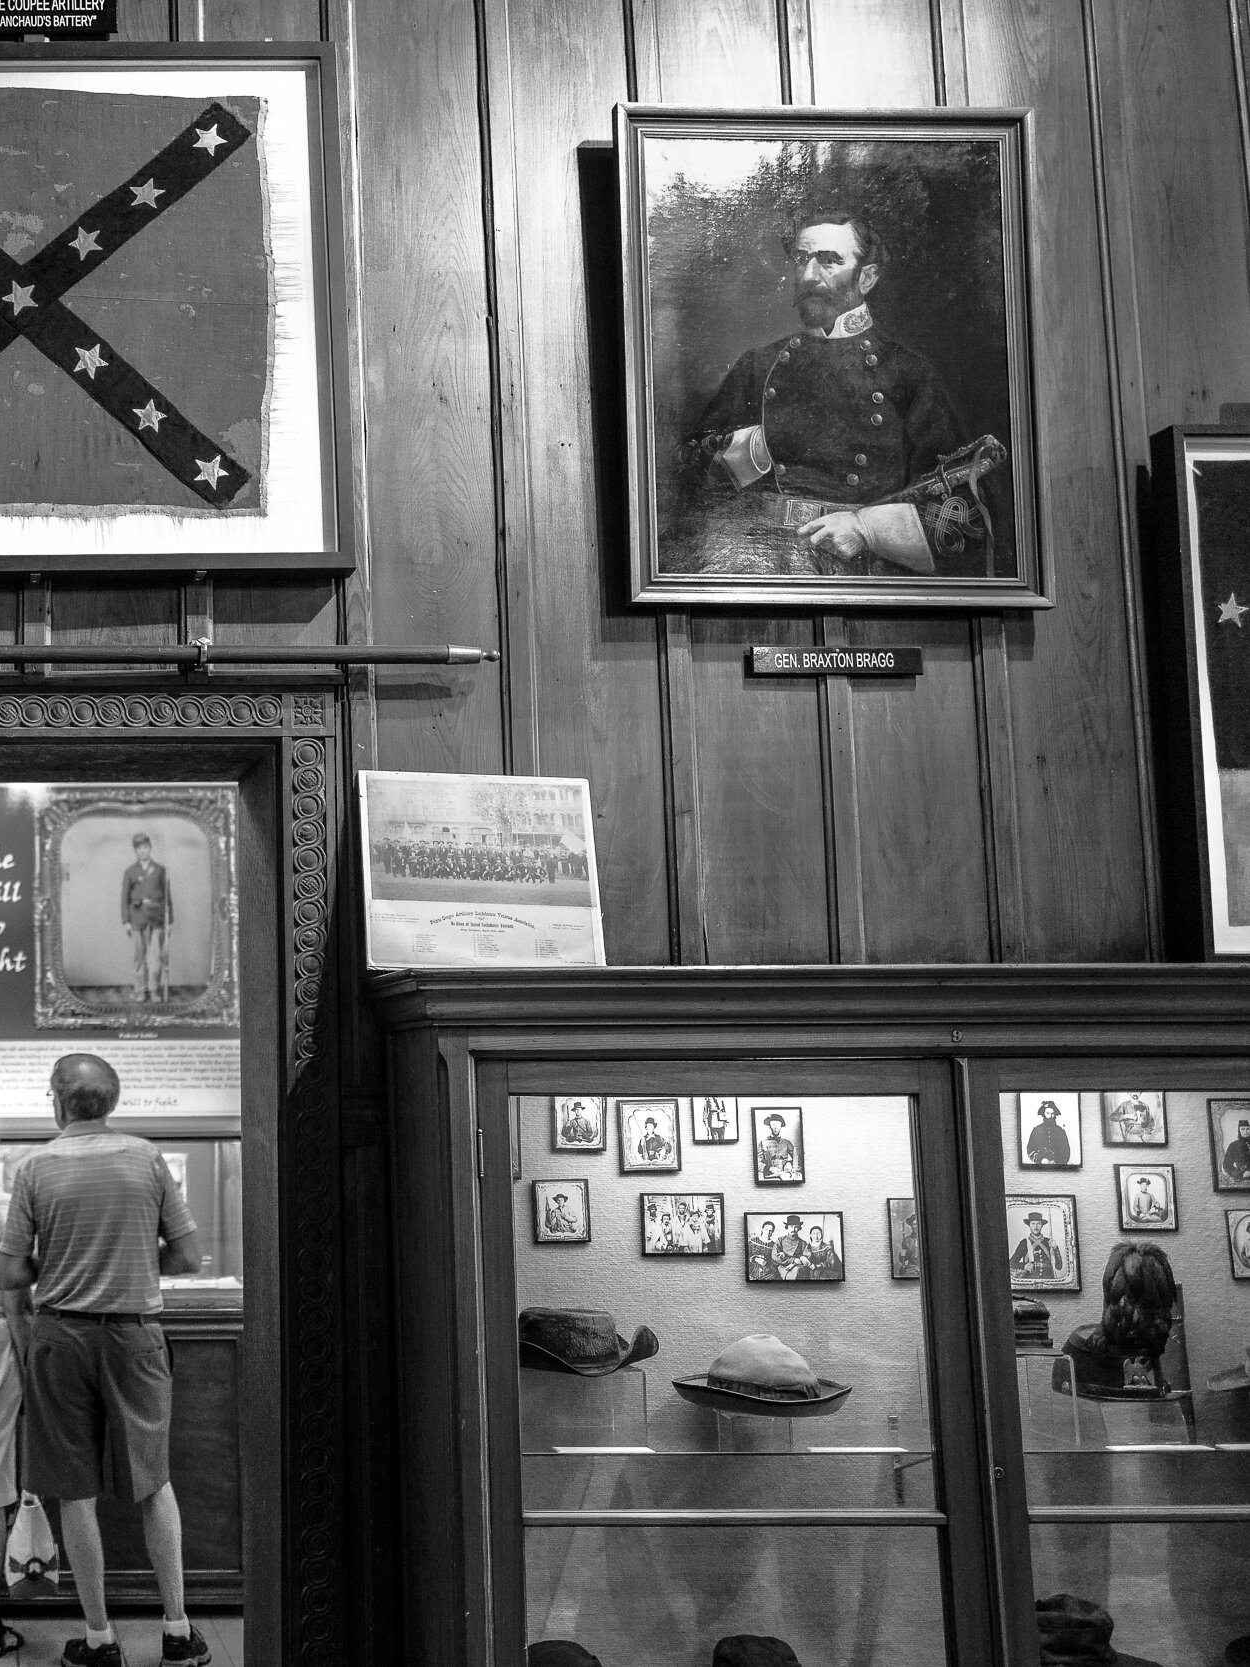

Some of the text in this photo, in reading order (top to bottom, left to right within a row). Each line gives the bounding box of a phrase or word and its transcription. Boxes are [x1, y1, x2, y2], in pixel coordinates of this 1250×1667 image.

[8, 0, 50, 11] COUPEE
[51, 0, 105, 11] ARTILLERY
[774, 652, 894, 668] GEN. BRAXTON BRAGG
